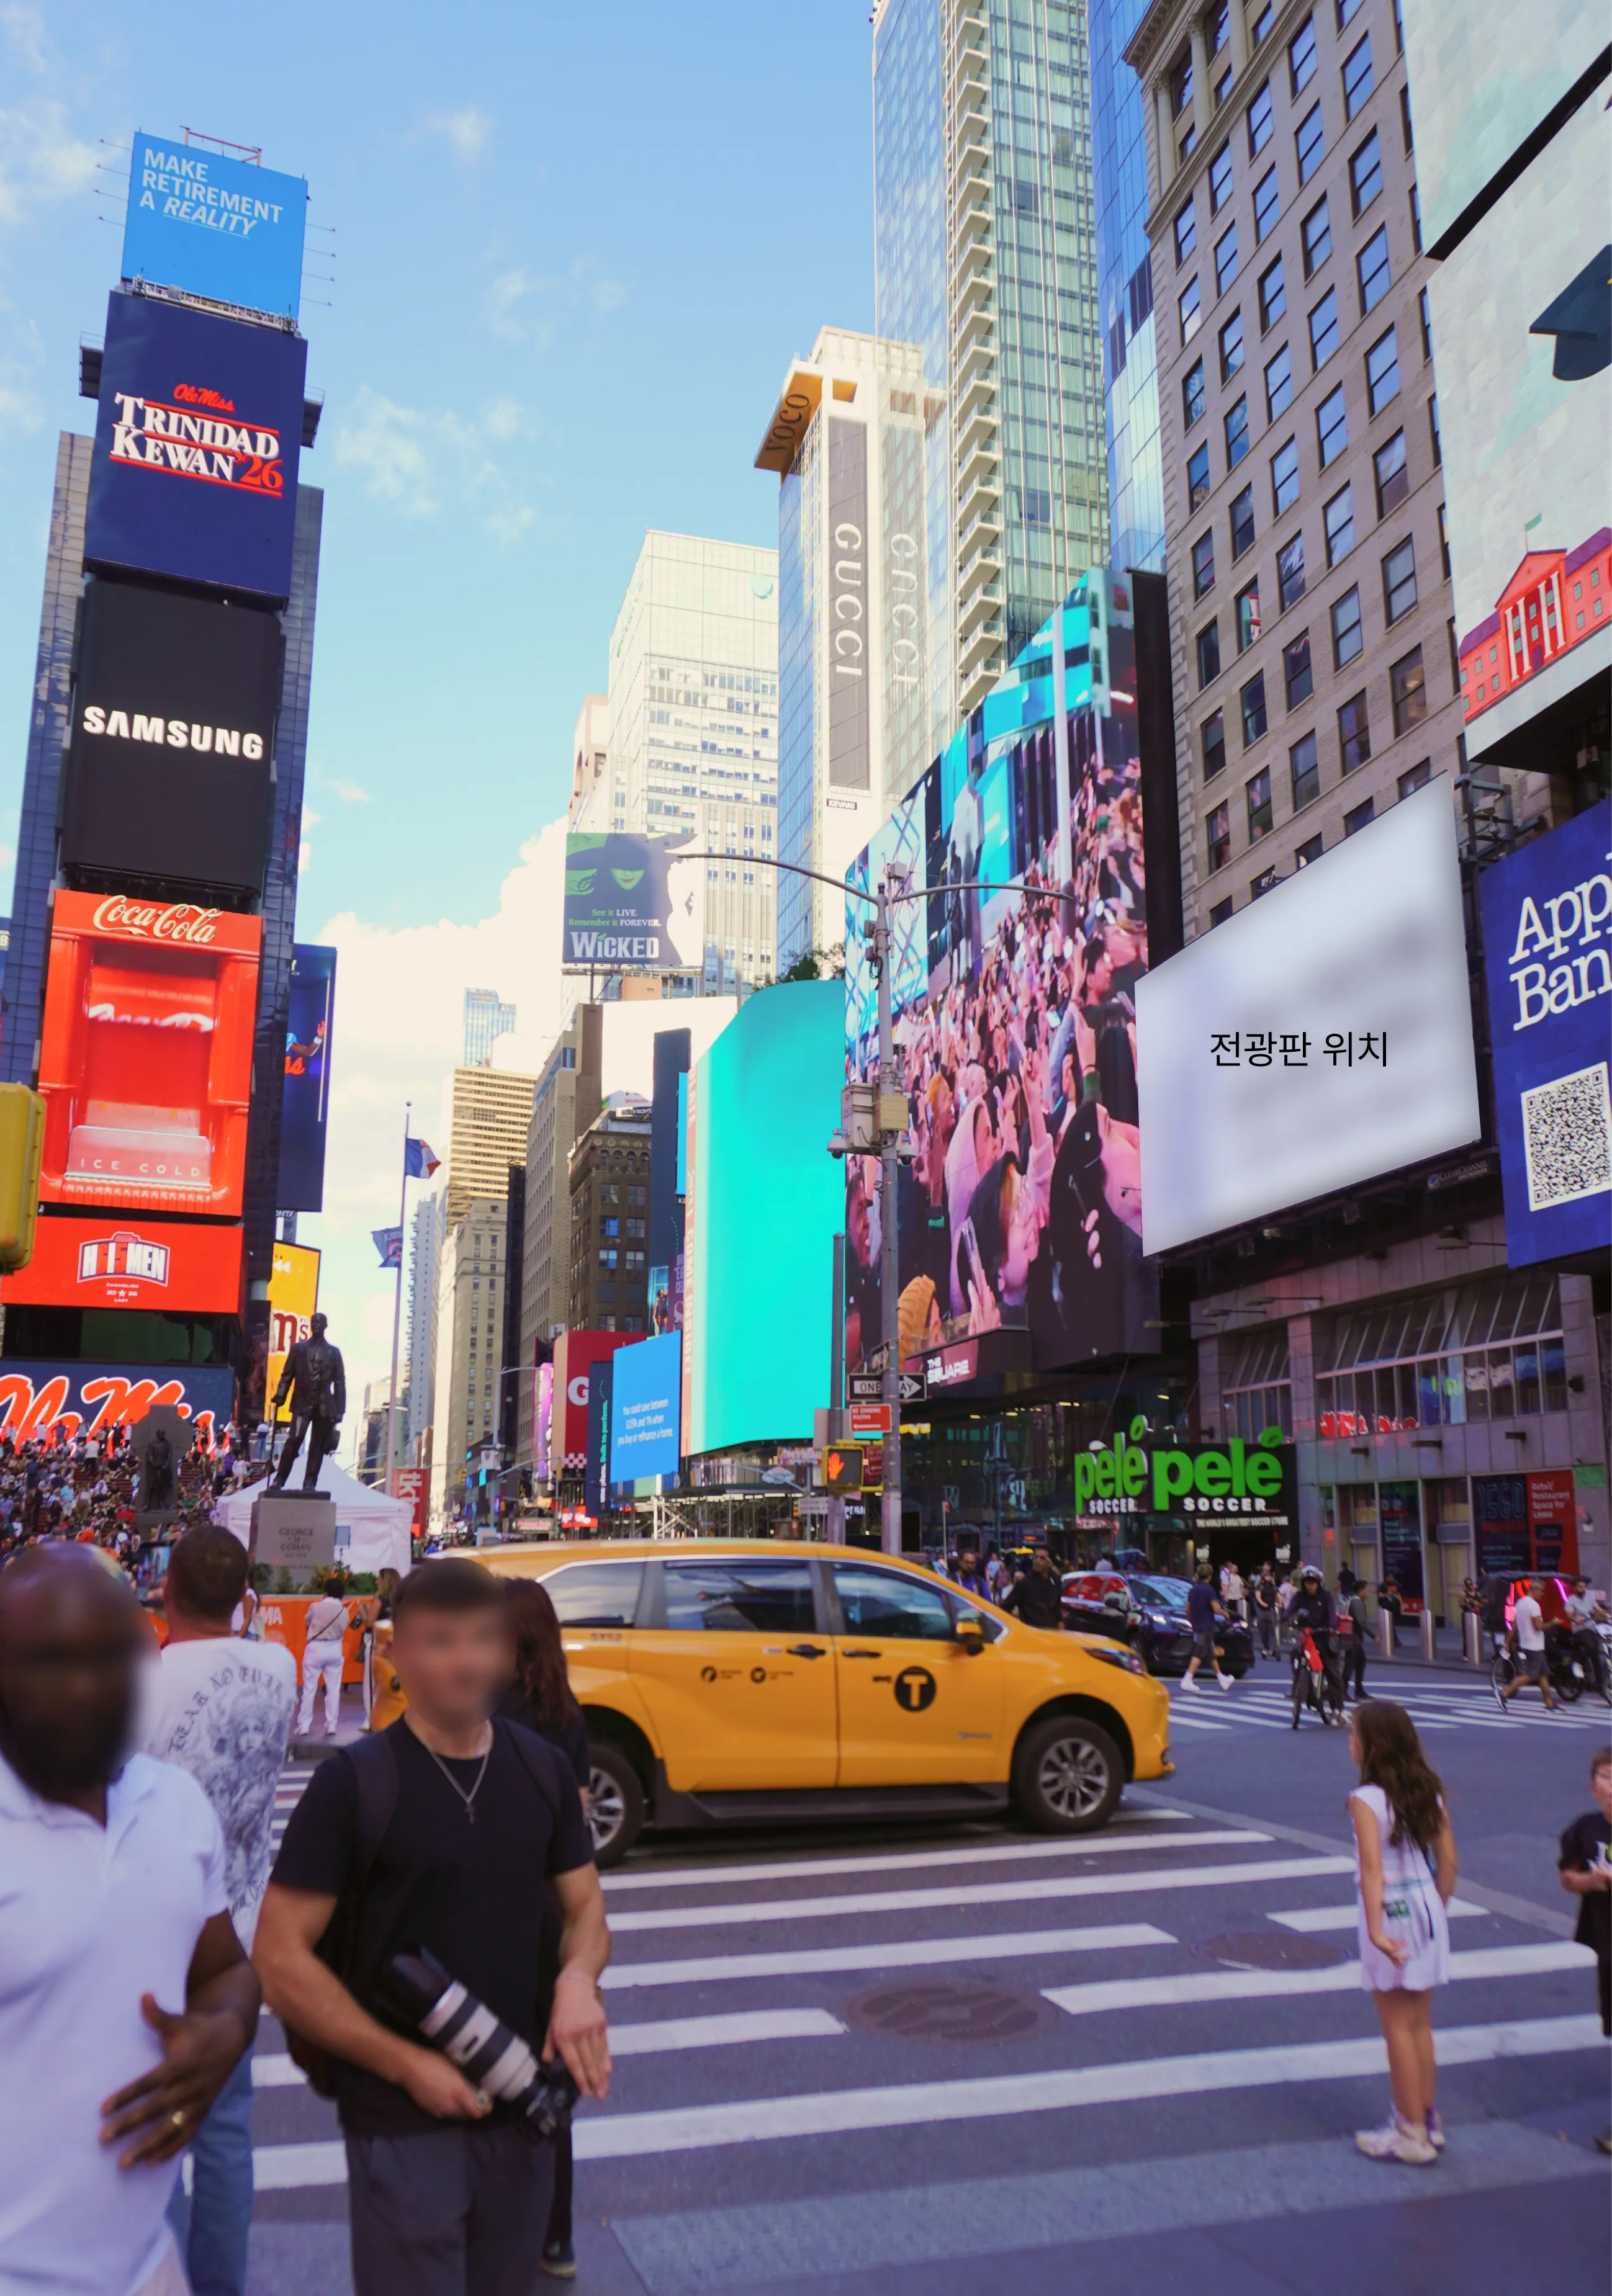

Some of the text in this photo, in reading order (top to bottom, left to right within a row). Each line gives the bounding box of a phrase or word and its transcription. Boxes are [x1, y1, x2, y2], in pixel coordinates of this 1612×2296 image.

[144, 147, 208, 181] MAKE
[142, 169, 283, 222] RETIREMENT
[139, 190, 258, 236] A REALITY
[114, 392, 279, 459] TRINIDAD
[110, 423, 235, 482] KEWAN
[835, 522, 862, 676] GUCCI
[83, 706, 264, 760] SAMSUNG
[1508, 852, 1612, 964] App
[80, 1158, 201, 1177] ICE COLD
[927, 1357, 941, 1368] THE
[860, 1383, 914, 1392] ONE AY
[398, 1471, 422, 1515] tkt
[1089, 1497, 1138, 1514] SOCCER
[1183, 1497, 1266, 1512] SOCCER
[1532, 1491, 1570, 1500] Restaurant
[1196, 1518, 1205, 1528] THE
[1534, 1511, 1554, 1519] Lease
[279, 1528, 313, 1537] GEORGE
